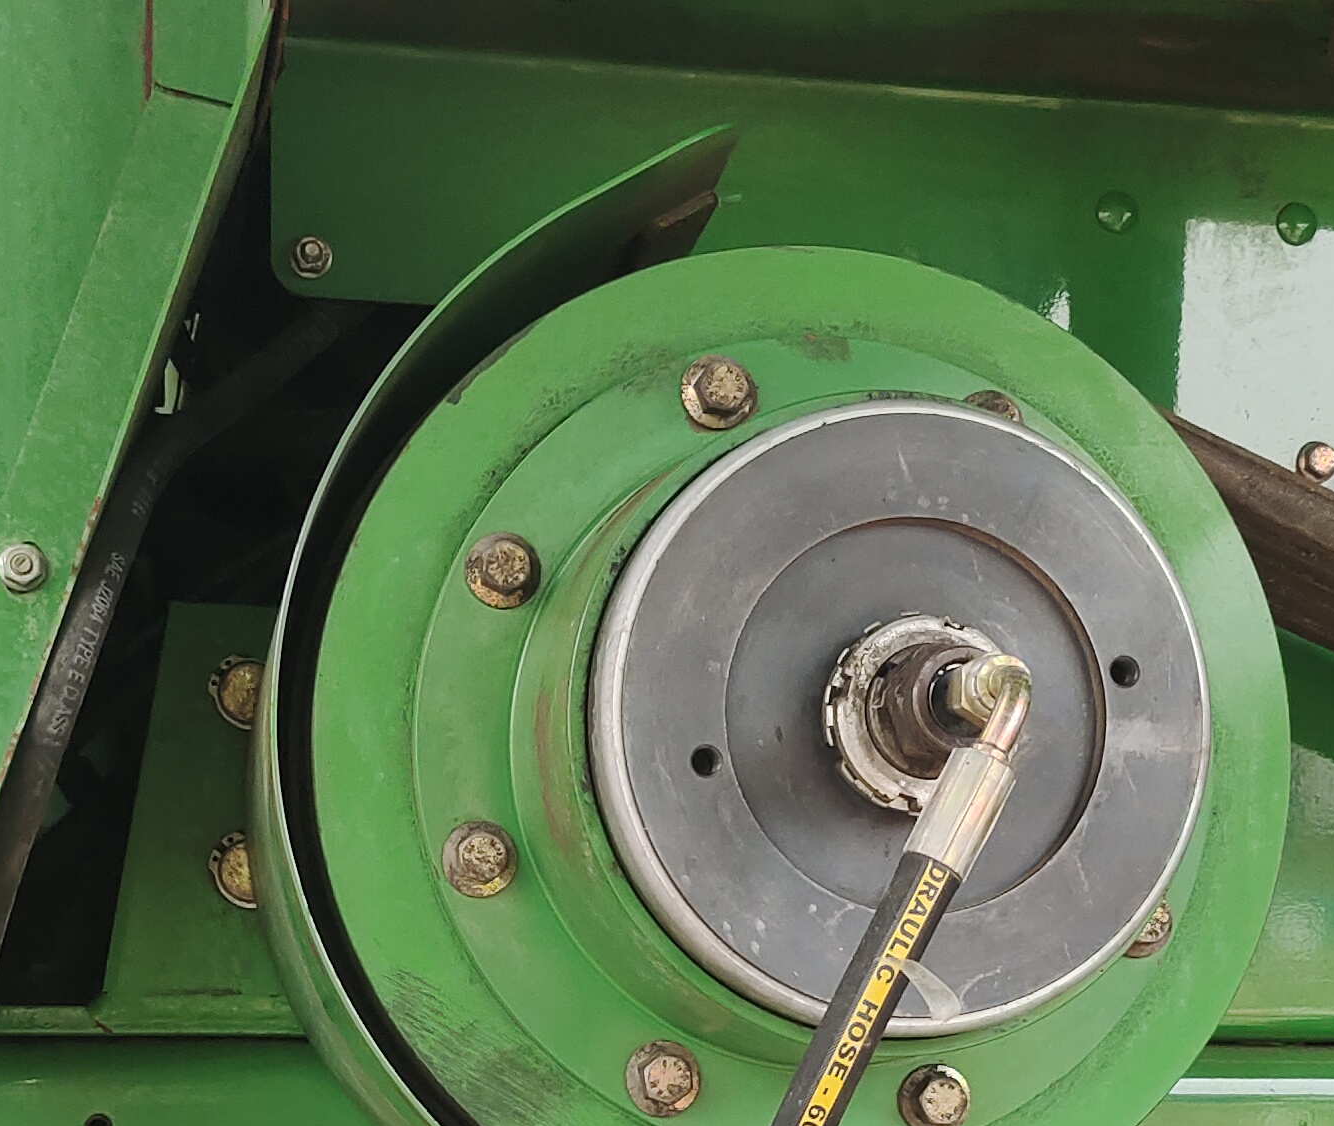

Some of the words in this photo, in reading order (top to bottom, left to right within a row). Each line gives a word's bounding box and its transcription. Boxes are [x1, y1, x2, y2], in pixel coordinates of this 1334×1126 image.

[104, 551, 126, 578] SAE
[75, 626, 101, 666] TYPE
[68, 669, 85, 685] E
[48, 685, 79, 737] CLASS
[827, 999, 879, 1082] HOSE
